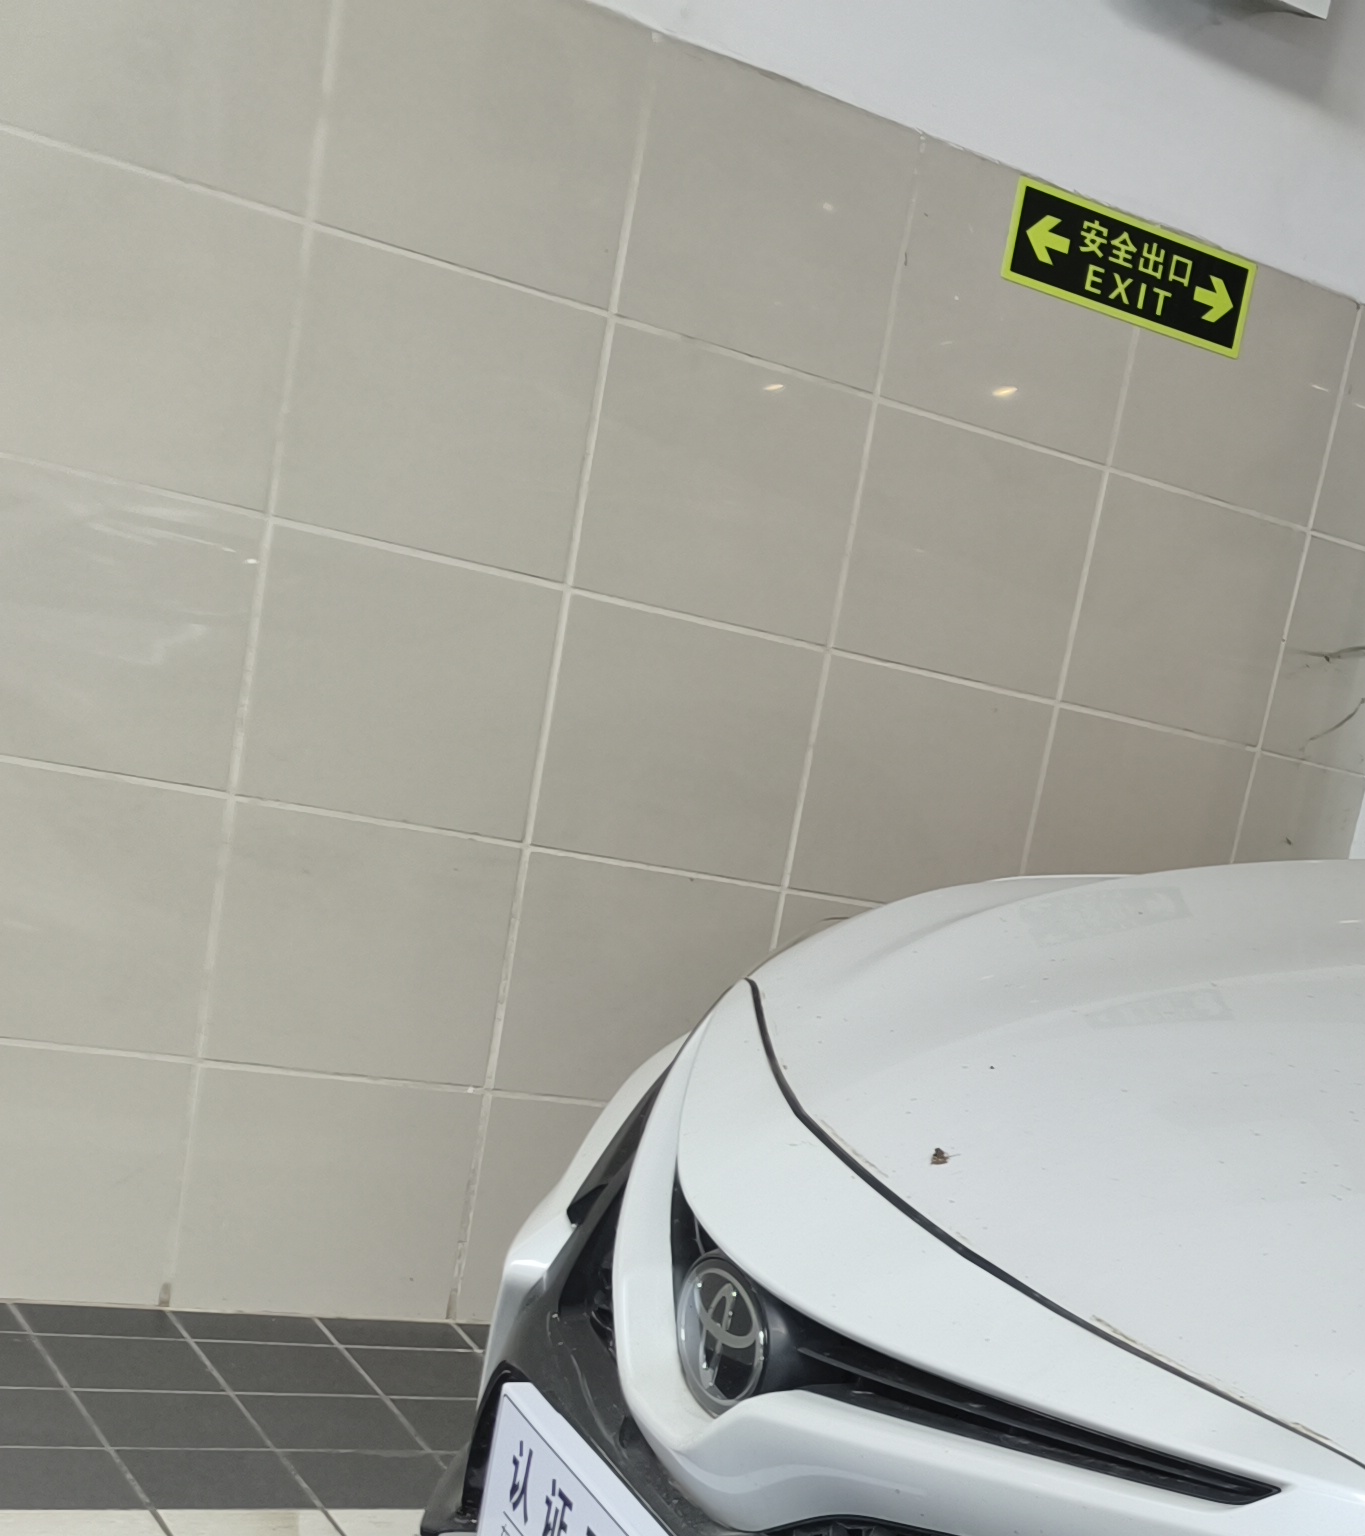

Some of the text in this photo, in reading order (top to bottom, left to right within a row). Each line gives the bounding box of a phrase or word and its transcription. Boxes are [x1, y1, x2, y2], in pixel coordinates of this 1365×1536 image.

[1078, 220, 1193, 288] 安全出口
[1084, 264, 1173, 317] EXIT
